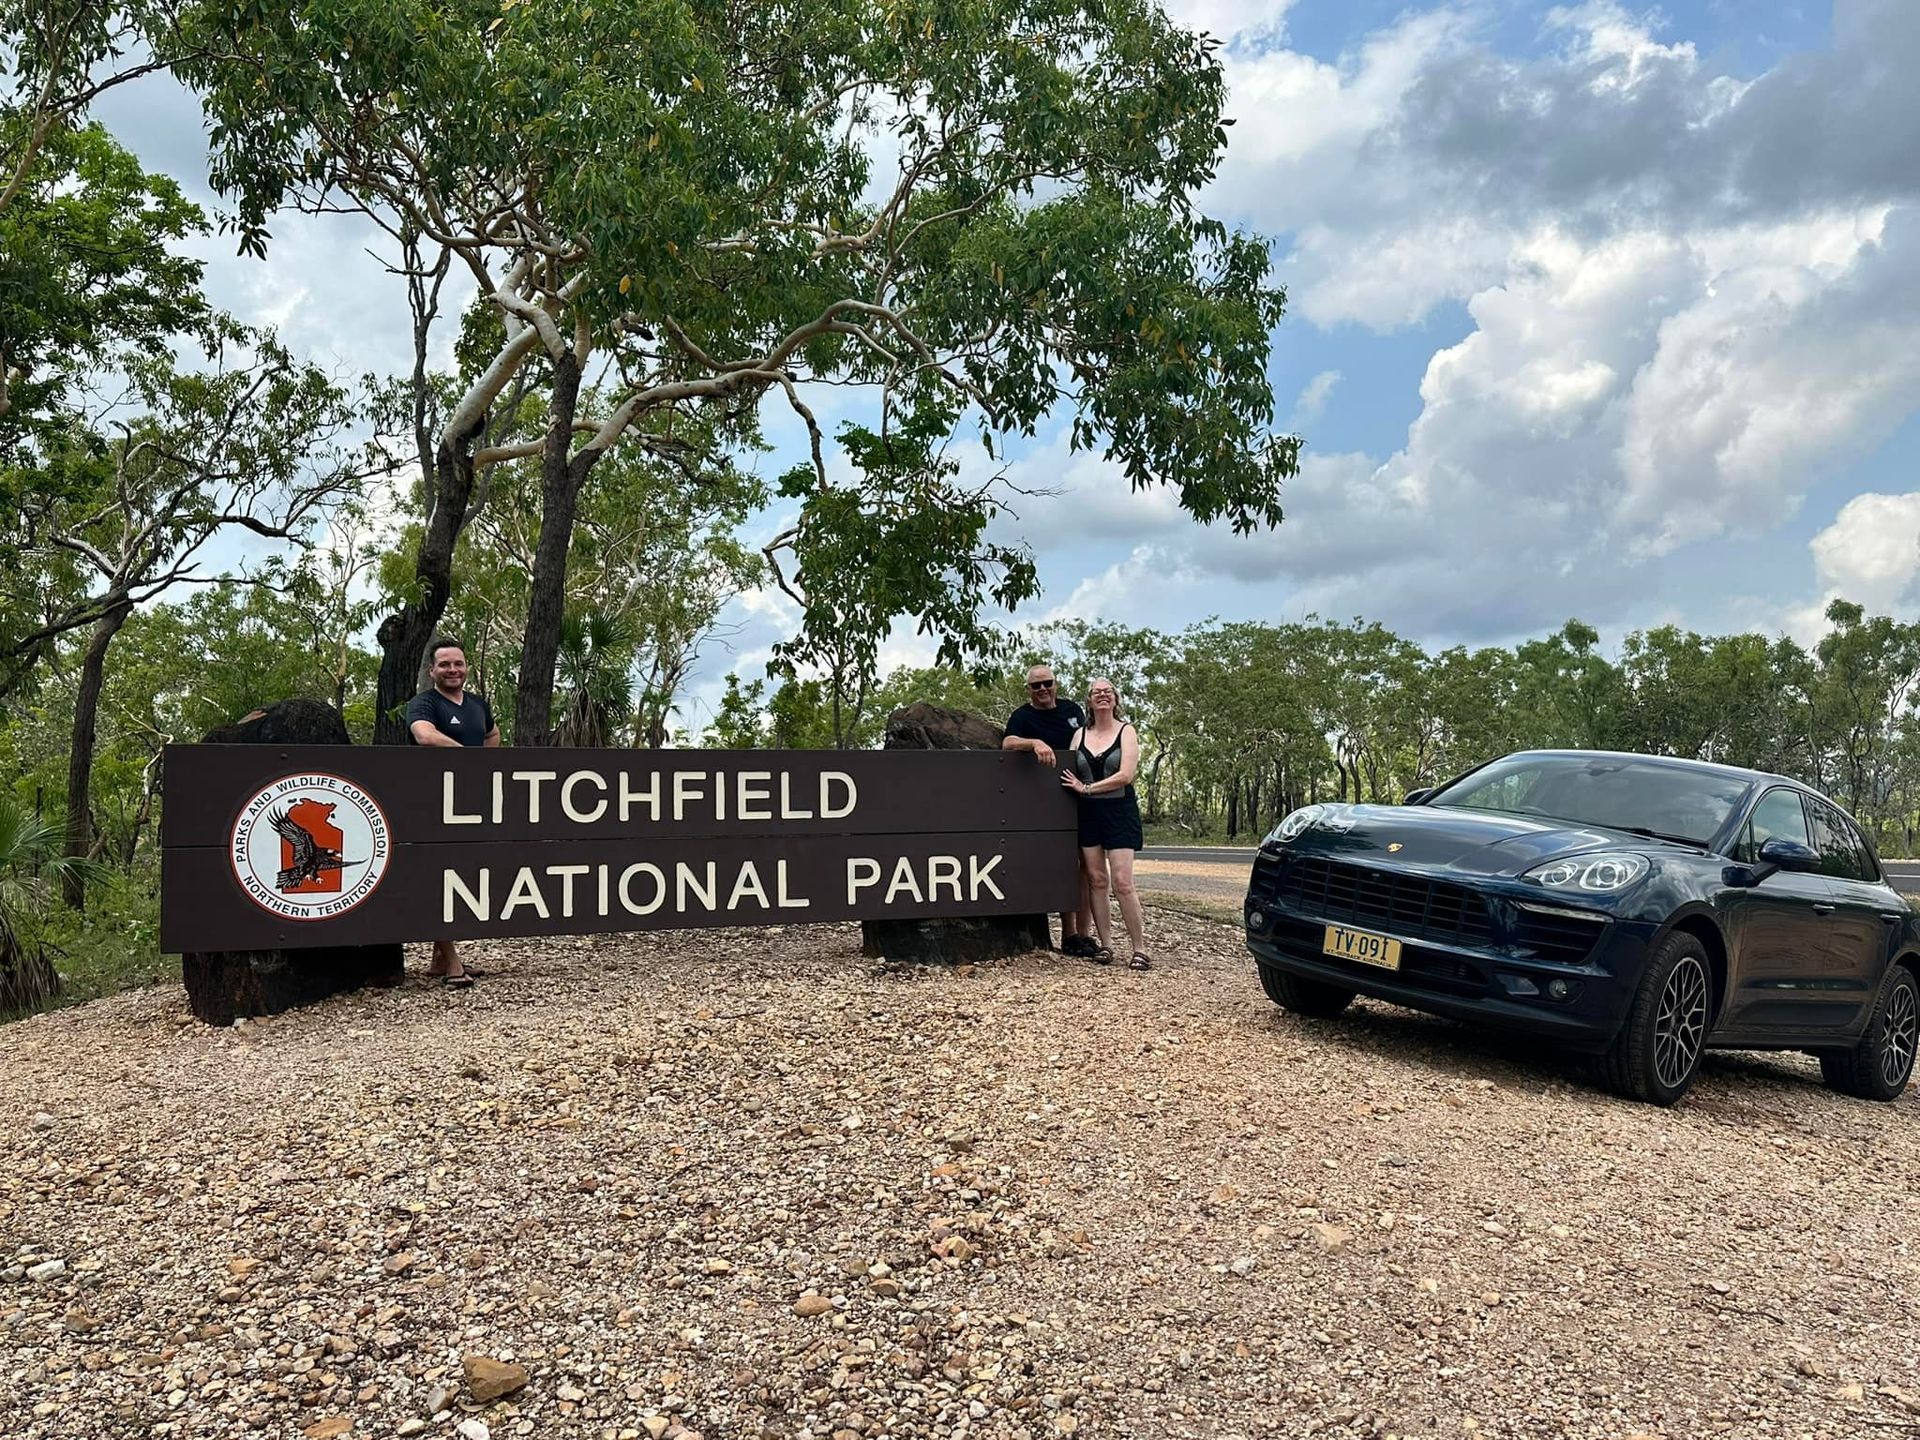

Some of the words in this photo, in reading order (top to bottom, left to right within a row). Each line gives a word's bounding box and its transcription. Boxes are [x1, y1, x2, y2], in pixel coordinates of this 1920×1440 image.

[236, 818, 251, 863] PARKS
[249, 792, 272, 817] AND
[276, 777, 337, 793] WILDLIFE
[342, 785, 387, 858] COMMISSION
[442, 770, 857, 824] LITCHFIELD
[243, 875, 310, 917] NORTHERN
[316, 871, 378, 916] TERRITORY
[442, 859, 810, 923] NATIONAL
[847, 854, 1005, 906] PARK
